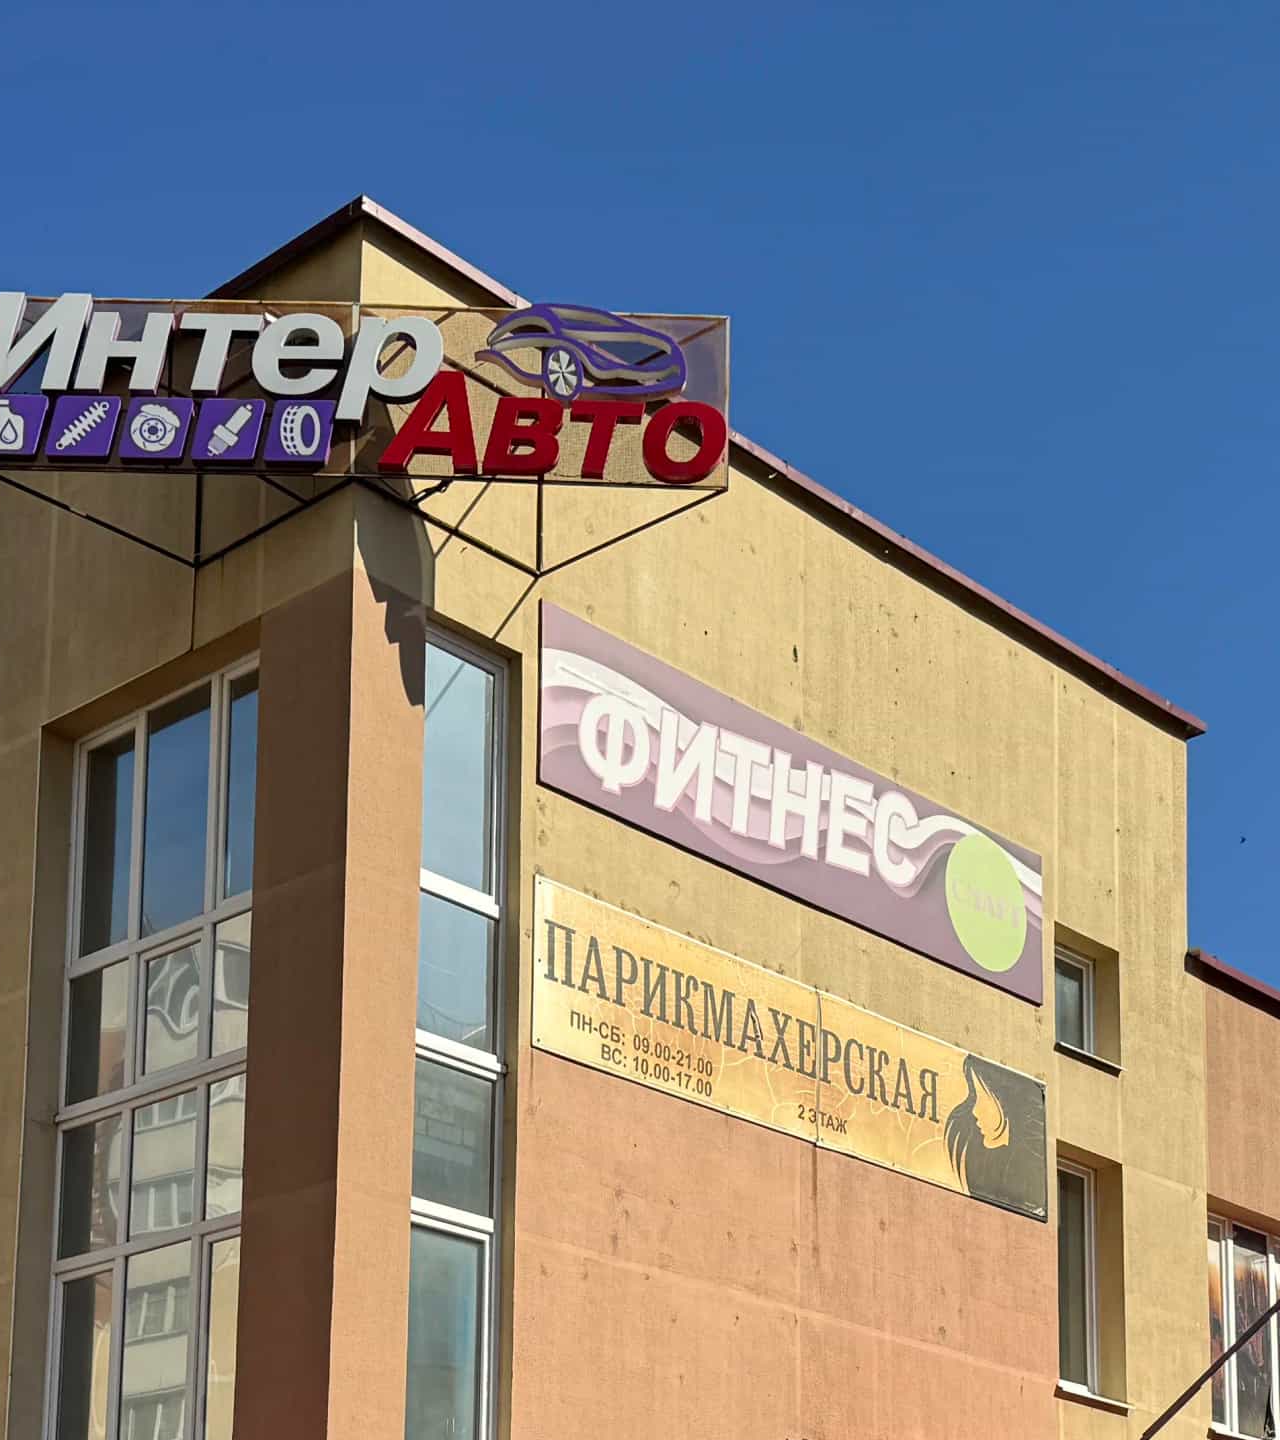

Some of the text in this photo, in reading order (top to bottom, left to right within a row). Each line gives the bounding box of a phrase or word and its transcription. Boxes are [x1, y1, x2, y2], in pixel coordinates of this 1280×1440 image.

[578, 690, 922, 888] ФИТНЕС
[544, 919, 940, 1124] ПАРИКМАХЕРСКАЯ
[570, 1009, 713, 1077] ПН-СБ: 09.00-21.00
[601, 1044, 712, 1097] ВС: 10.00-17.00
[797, 1104, 848, 1135] 2 ЭТАЖ
